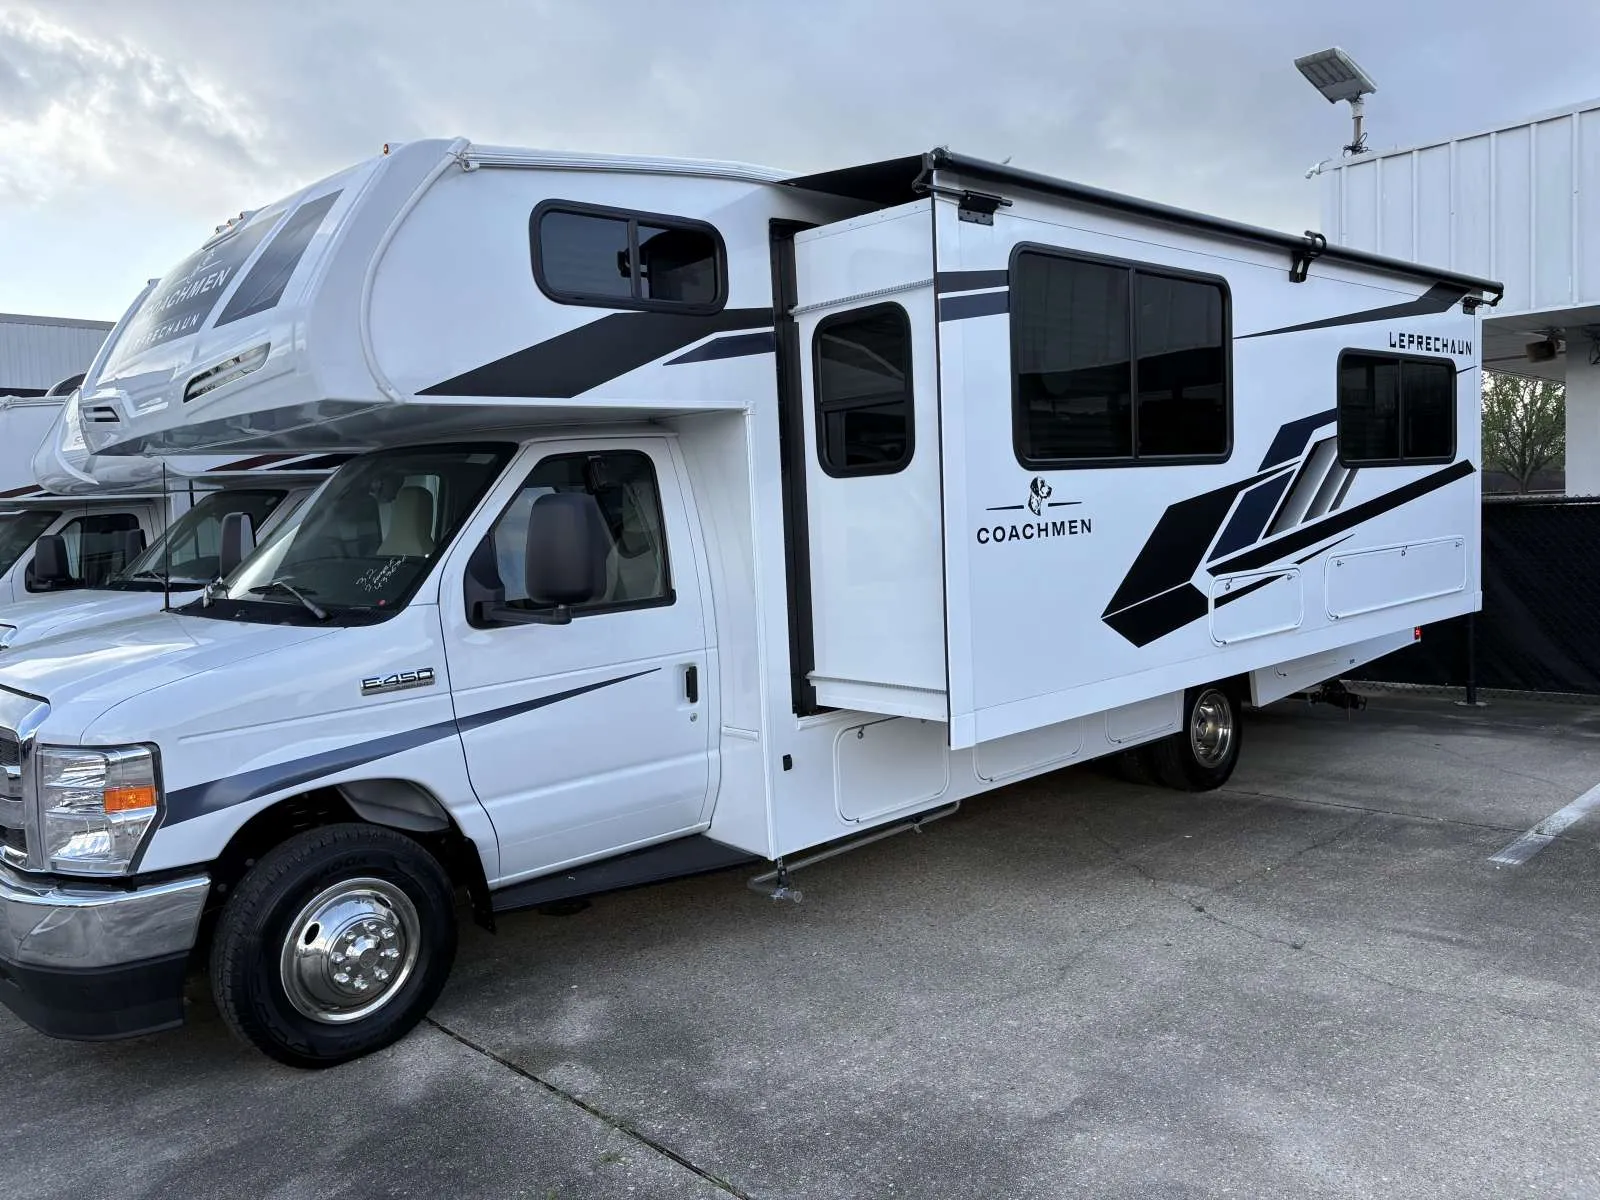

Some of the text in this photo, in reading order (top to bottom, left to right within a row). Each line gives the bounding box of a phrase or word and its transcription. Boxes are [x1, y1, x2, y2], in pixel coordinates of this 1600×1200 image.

[145, 266, 232, 315] OACHMEN
[1389, 331, 1472, 356] LEPRECHAUN
[976, 518, 1092, 544] COACHMEN
[361, 667, 435, 690] E-450
